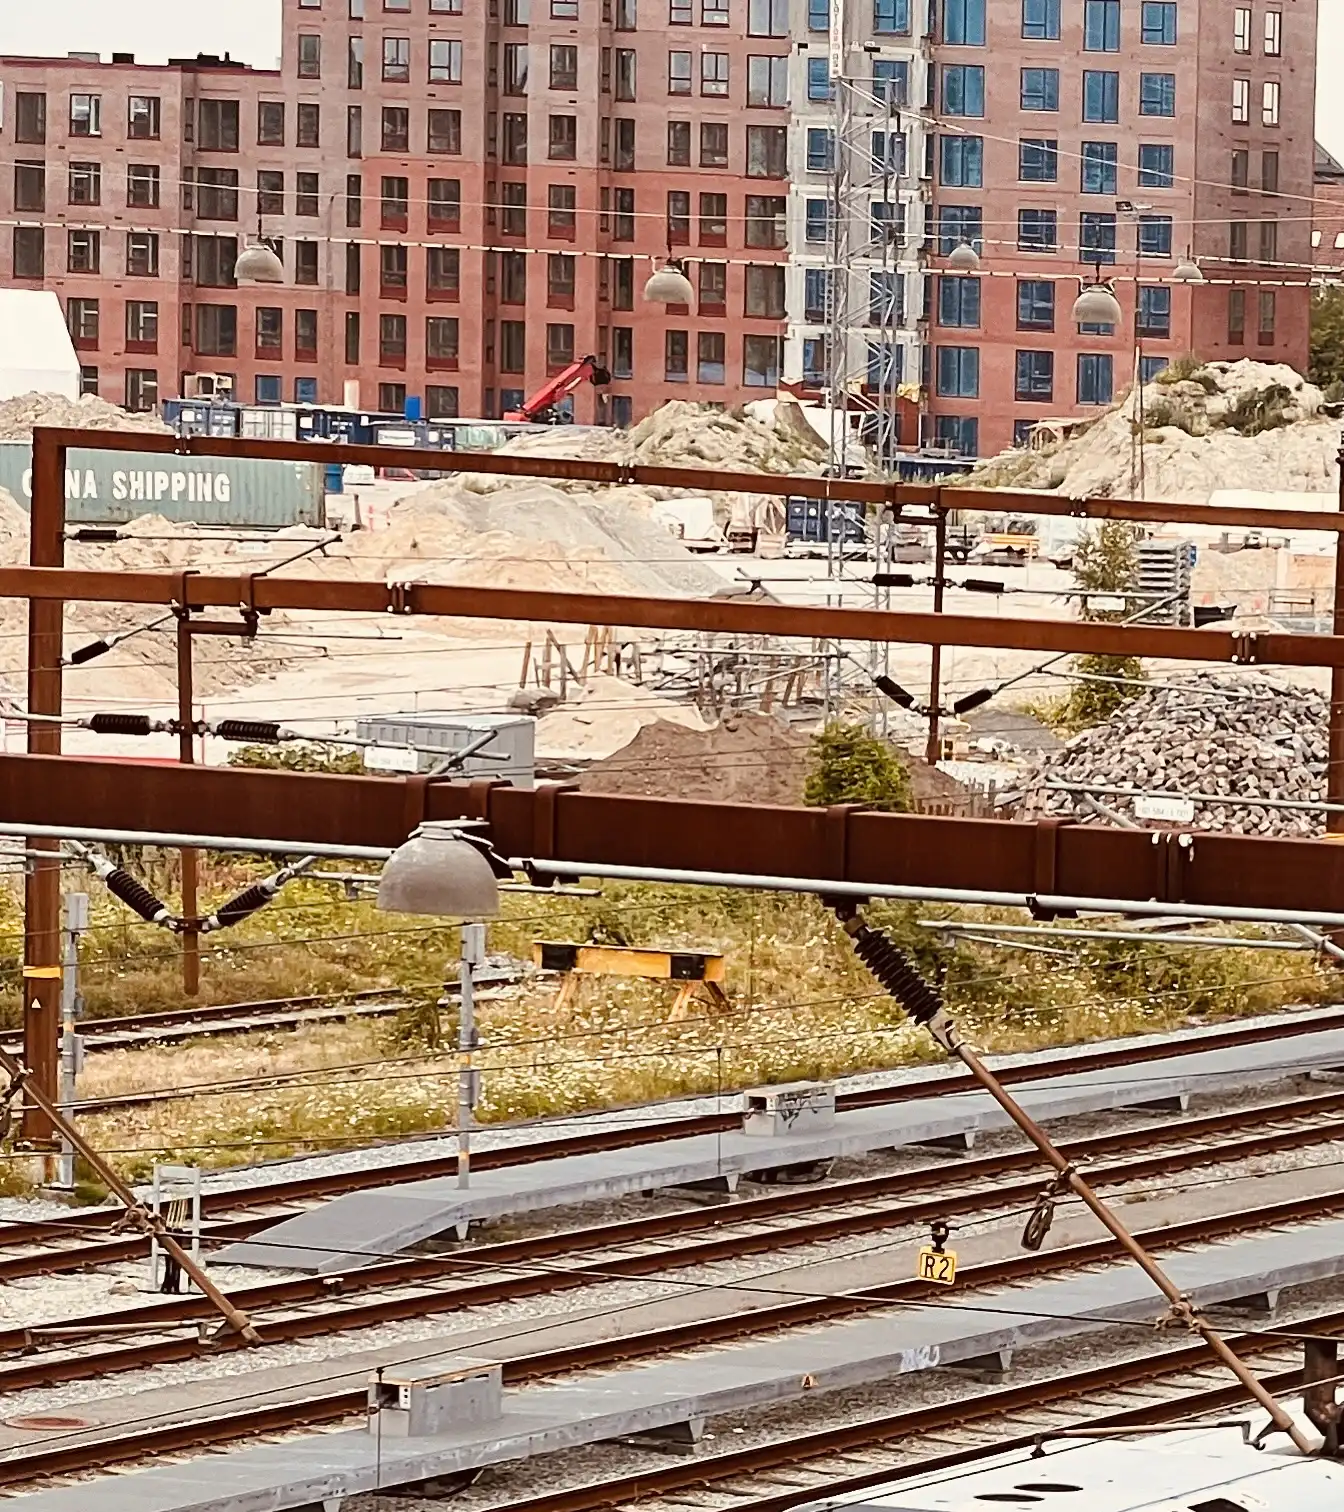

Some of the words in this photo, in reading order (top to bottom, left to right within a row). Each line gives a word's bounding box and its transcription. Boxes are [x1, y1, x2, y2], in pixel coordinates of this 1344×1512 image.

[22, 468, 98, 500] CNA
[112, 470, 231, 502] SHIPPING
[925, 1255, 949, 1281] R2
